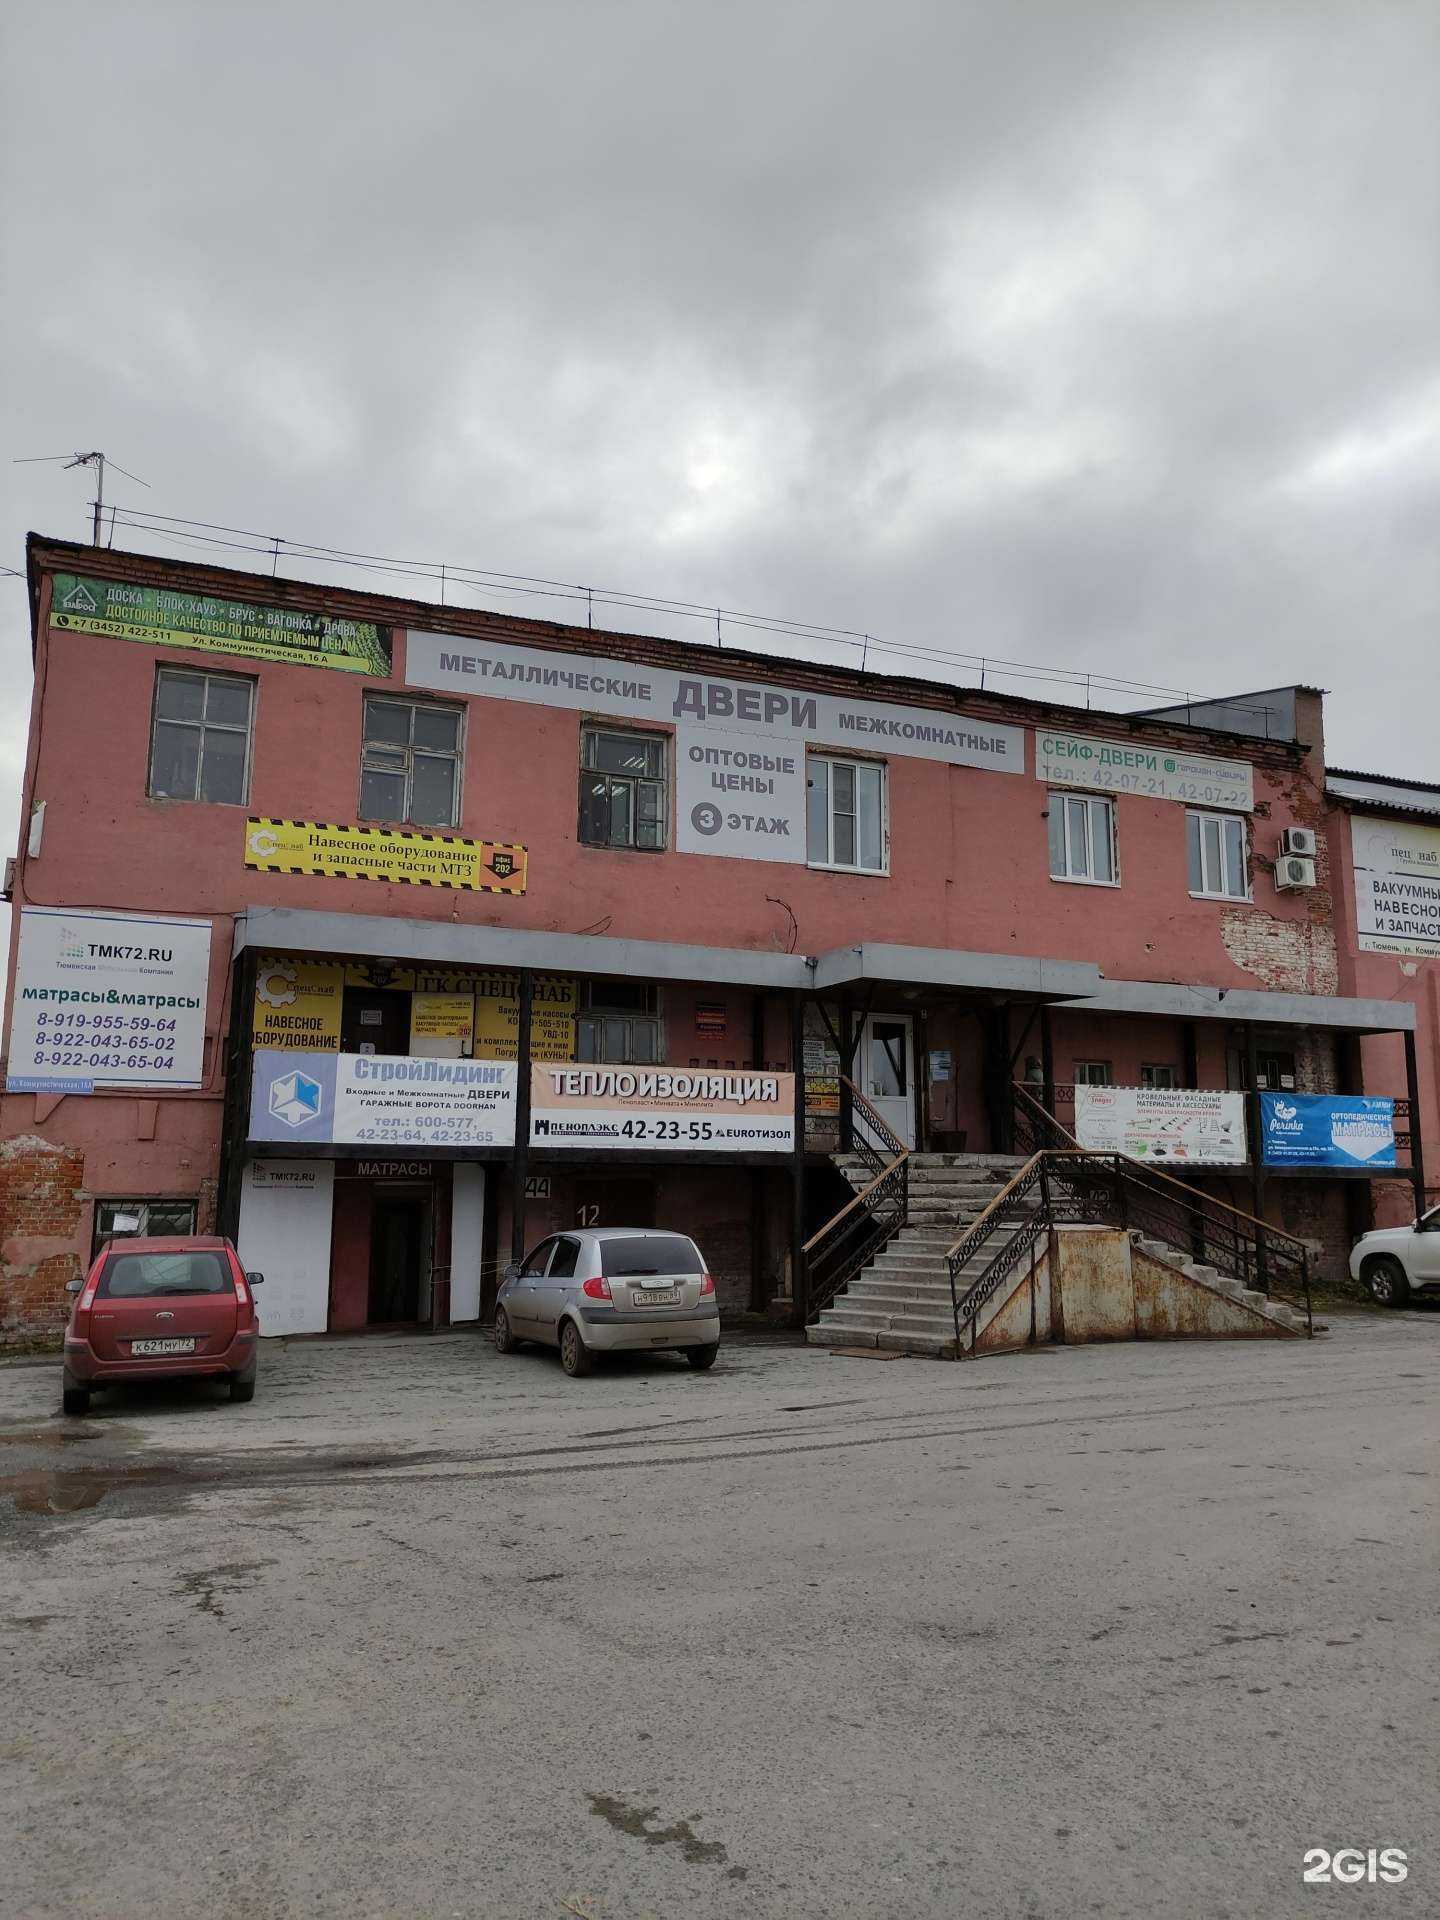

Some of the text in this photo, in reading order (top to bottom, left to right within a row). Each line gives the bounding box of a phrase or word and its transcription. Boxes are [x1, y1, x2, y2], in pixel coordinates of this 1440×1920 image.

[107, 588, 143, 604] ДОСКА
[156, 596, 217, 615] БЛОК-ХАУС
[229, 607, 255, 622] БРУС
[267, 613, 312, 631] ВАГОНКА
[105, 604, 169, 625] ДОСТОЙНОЕ
[172, 613, 226, 633] КАЧЕСТВО
[229, 624, 242, 635] ПО
[245, 626, 319, 648] ПРИЕМЛЕМЫМ
[73, 619, 87, 629] +7
[90, 620, 125, 635] (3452)
[128, 626, 171, 640] 422-511
[309, 654, 319, 662] 16
[440, 652, 1007, 755] МЕТАЛЛИЧЕСКИЕ ДВЕРИ МЕЖКОМНАТНЫЕ
[688, 745, 796, 774] ОПТОВЫЕ
[1042, 738, 1157, 771] СЕЙФ-ДВЕРИ
[711, 771, 774, 795] ЦЕНЫ
[1178, 783, 1249, 807] 42-07-22
[726, 812, 790, 836] ЭТАЖ
[308, 833, 376, 853] Навесное
[379, 842, 478, 864] оборудование
[313, 853, 323, 863] и
[327, 853, 394, 869] запасные
[397, 860, 437, 873] части
[495, 863, 511, 874] 202
[1375, 917, 1384, 930] И
[88, 943, 173, 962] TMK72.RU
[22, 987, 200, 1010] матрасы&матрасы
[37, 1012, 177, 1032] 8-919-955-59-64
[264, 1014, 324, 1031] НАВЕСНОЕ
[35, 1032, 176, 1051] 8-922-043-65-02
[34, 1051, 174, 1070] 8-922-043-65-04
[354, 1058, 504, 1086] СтройЛидинг
[346, 1087, 386, 1097] Входные
[397, 1089, 465, 1099] Межкомнатные
[467, 1090, 511, 1101] ДВЕРИ
[550, 1070, 779, 1105] ТЕПЛОИЗОЛЯЦИЯ
[360, 1099, 496, 1110] ГАРАЖНЫЕ ВОРОТА DOORHAN
[374, 1116, 478, 1130] тел.: 600-577,
[1331, 1112, 1392, 1122] ОРТОПЕДИЧЕСКИЕ
[356, 1128, 494, 1143] 42-23-64, 42-23-65
[551, 1122, 619, 1132] ПЕНОПЛЭКС
[621, 1120, 713, 1141] 42-23-55
[1332, 1121, 1392, 1137] МАТРАСЫ
[357, 1162, 433, 1177] МАТРАСЫ
[576, 1204, 600, 1227] 12
